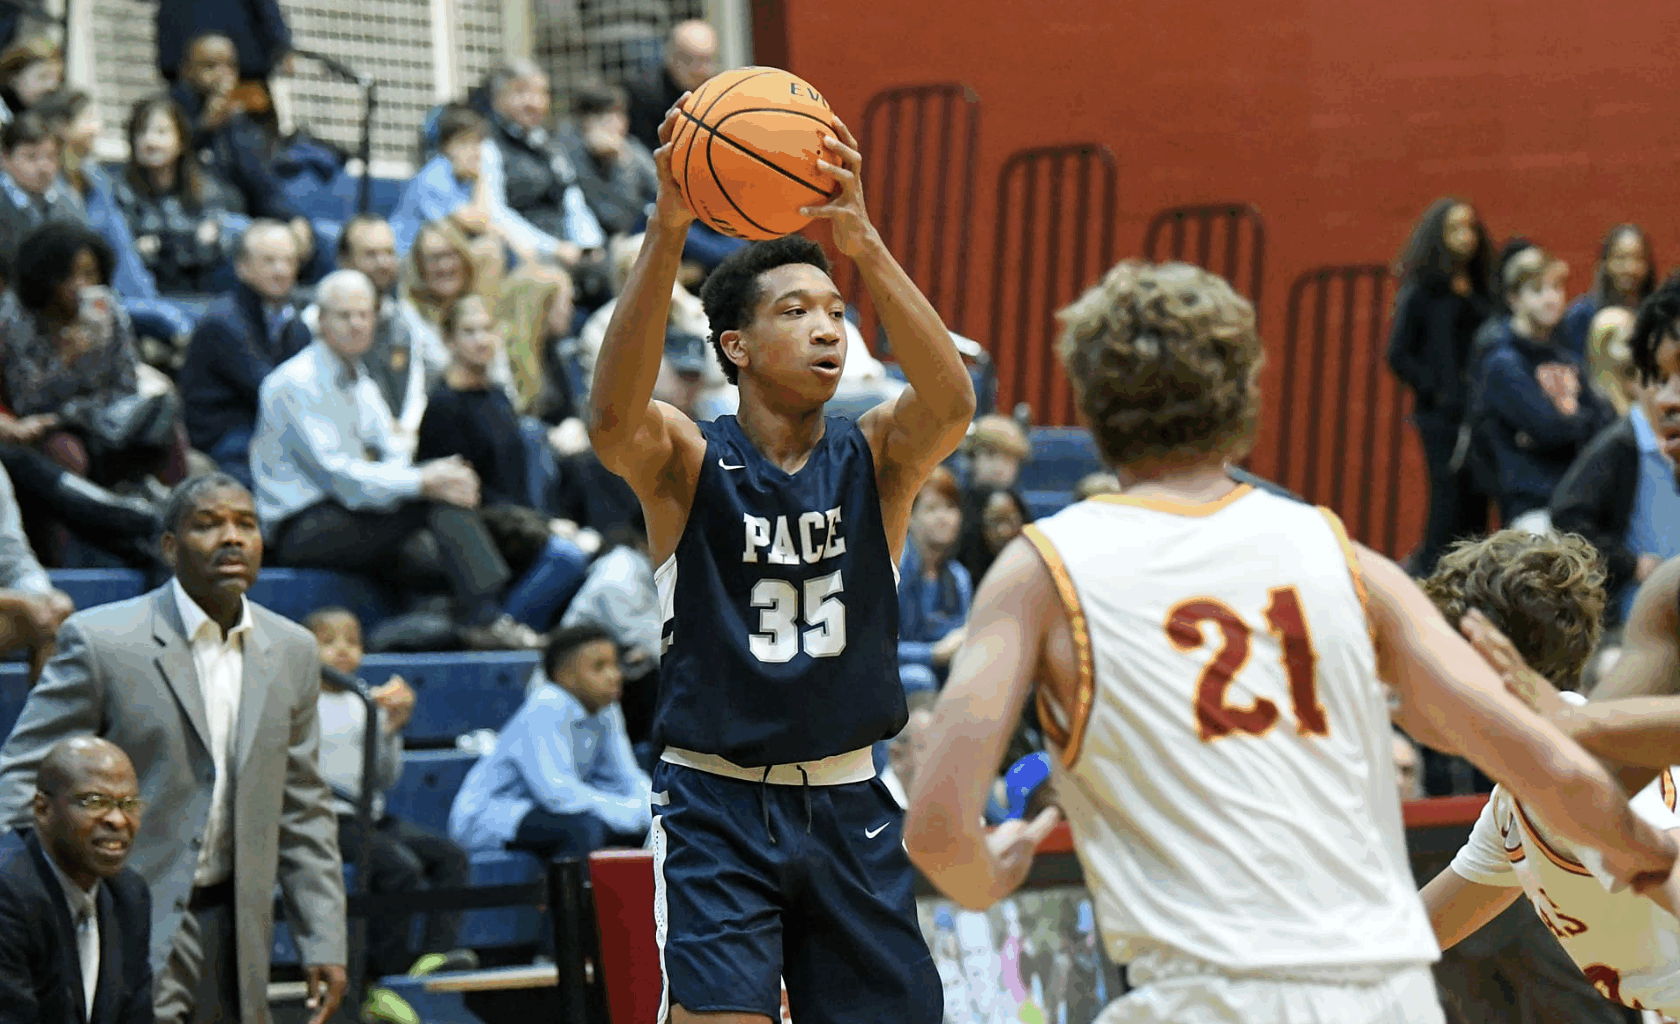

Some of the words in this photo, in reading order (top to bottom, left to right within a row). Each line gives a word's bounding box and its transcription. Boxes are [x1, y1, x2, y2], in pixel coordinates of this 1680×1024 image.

[742, 505, 847, 565] PACE
[748, 569, 846, 663] 35
[1162, 584, 1331, 743] 21
